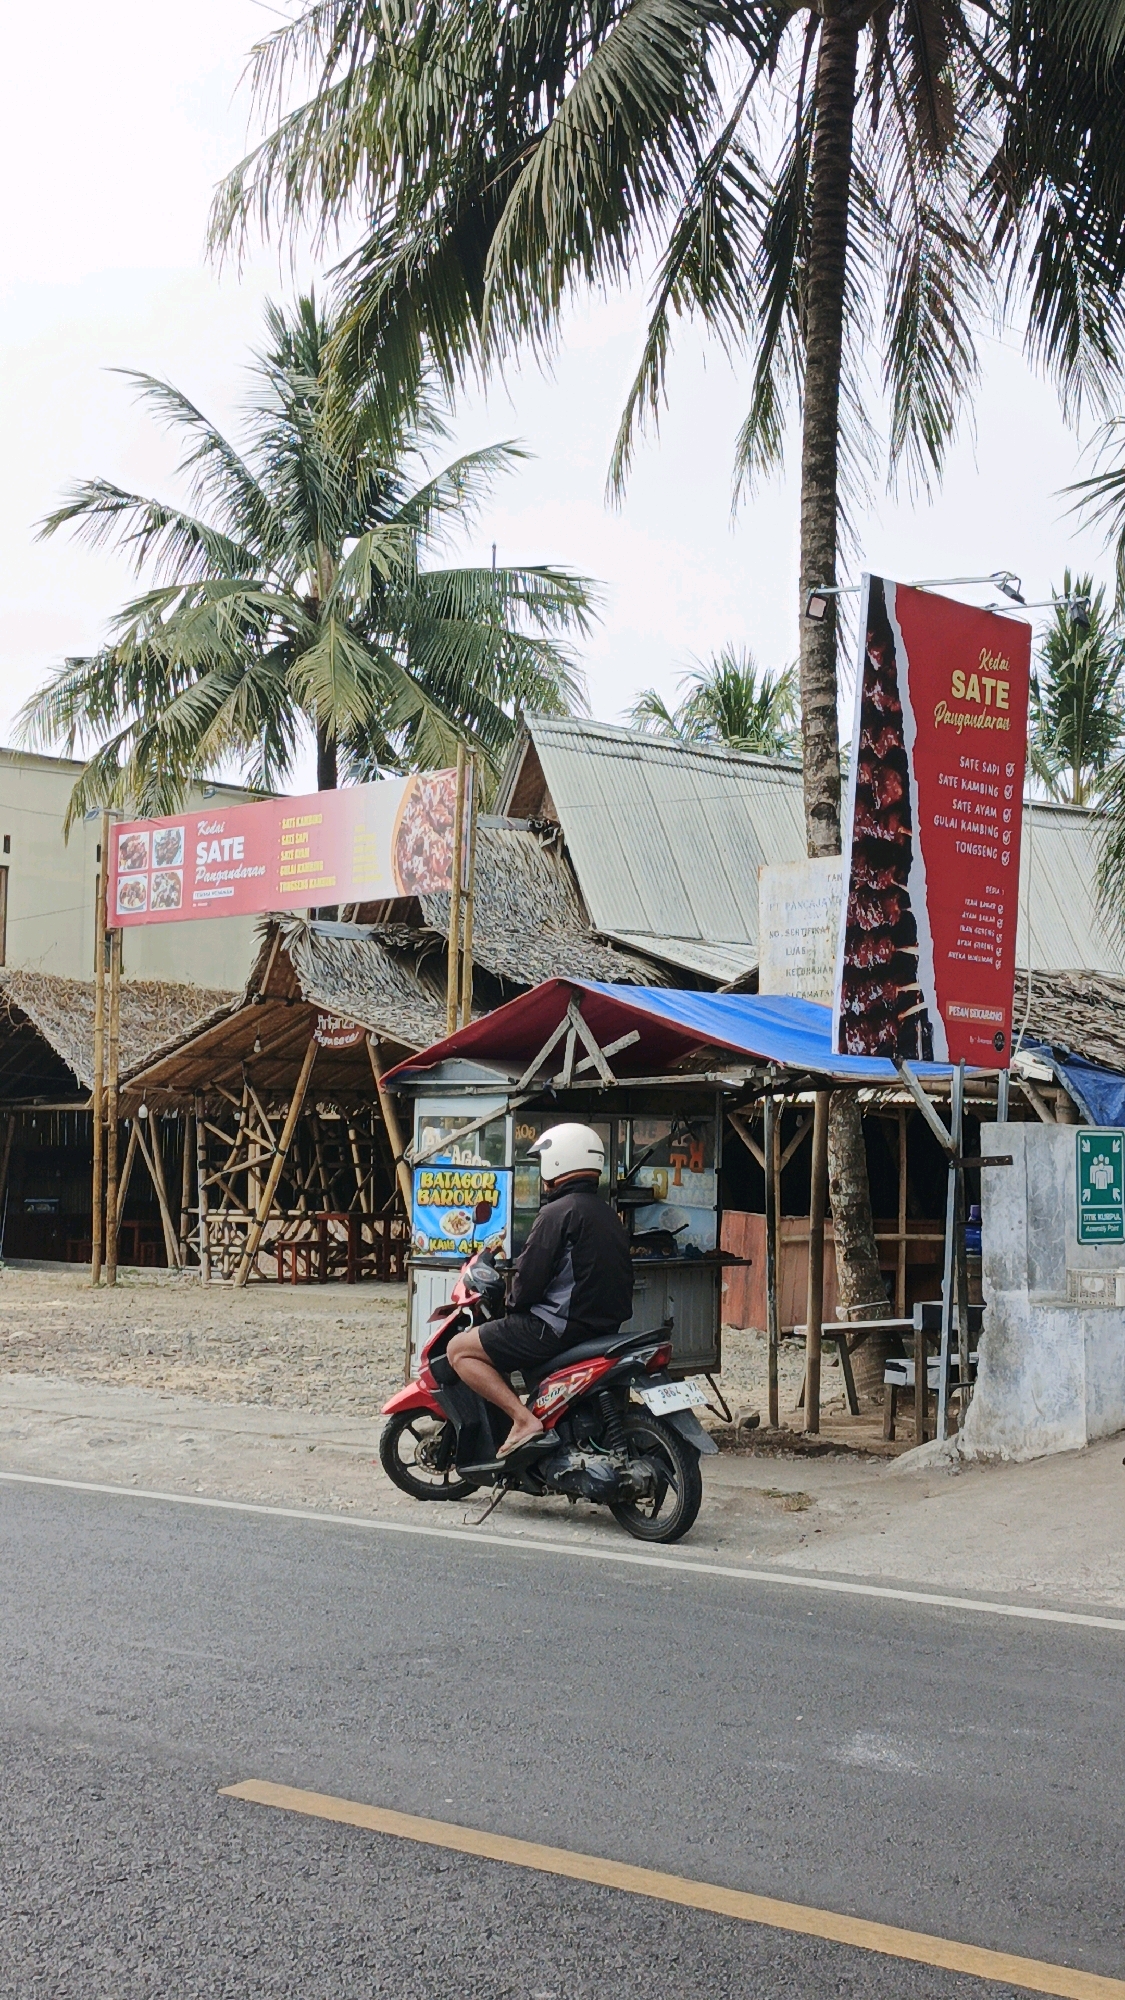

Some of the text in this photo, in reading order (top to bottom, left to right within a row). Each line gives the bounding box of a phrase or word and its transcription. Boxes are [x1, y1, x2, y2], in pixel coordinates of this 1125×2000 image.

[978, 647, 1010, 671] Kedai
[951, 669, 1010, 710] SATE
[934, 701, 1011, 734] Pangandaran
[960, 756, 1000, 776] SATE SAPI
[938, 773, 999, 797] SATE KAMBING
[952, 798, 997, 818] SATE AYAM
[197, 820, 226, 836] Kedai
[933, 814, 999, 839] GULAI KAMBING
[195, 835, 245, 866] SATE
[955, 840, 998, 859] TONGSENG
[194, 862, 267, 887] Pangandaran
[420, 1171, 496, 1190] BATAGOR
[417, 1188, 500, 1207] BAROKAH
[428, 1238, 456, 1252] KANG
